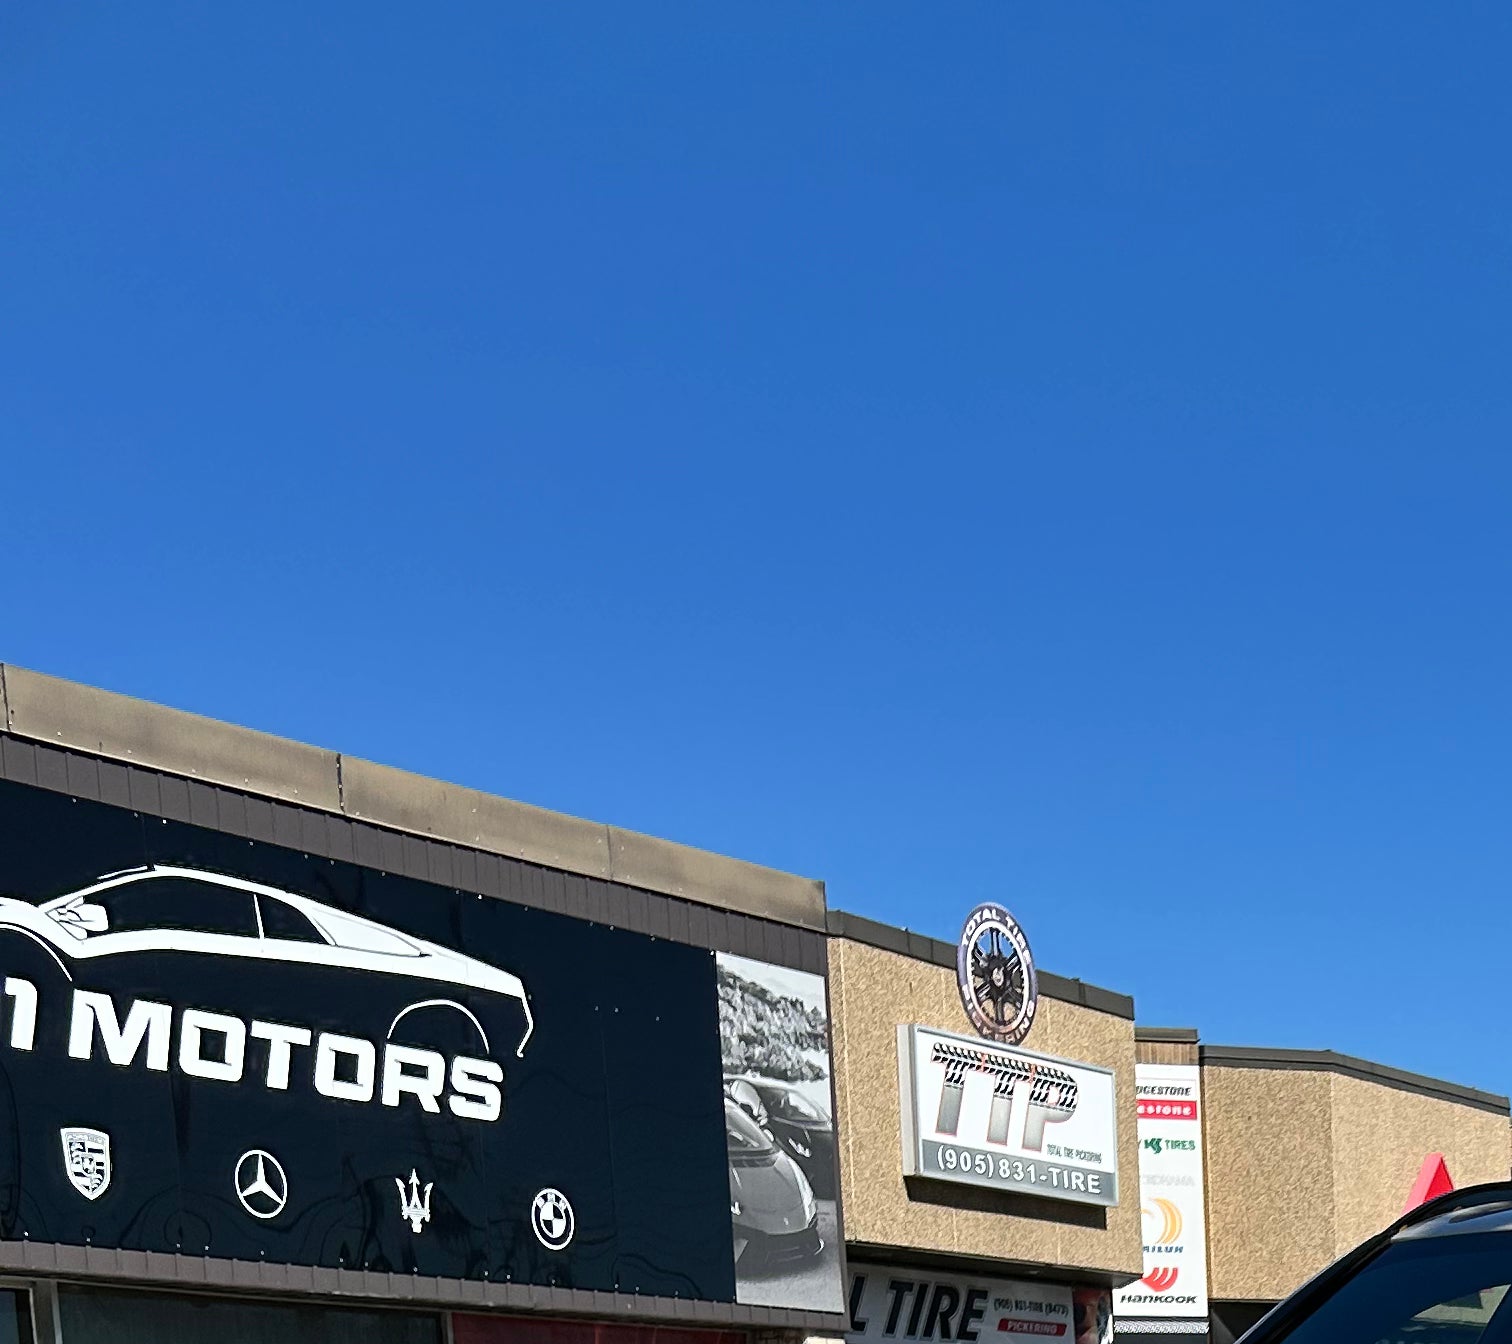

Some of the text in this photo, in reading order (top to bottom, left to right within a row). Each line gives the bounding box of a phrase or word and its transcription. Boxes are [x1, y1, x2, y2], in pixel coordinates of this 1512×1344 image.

[68, 987, 504, 1122] MOTORS
[937, 1145, 1101, 1194] (905) 831-TIRE
[1165, 1140, 1196, 1151] TIRES
[885, 1280, 988, 1342] TIRE
[1007, 1320, 1057, 1335] PICKERING
